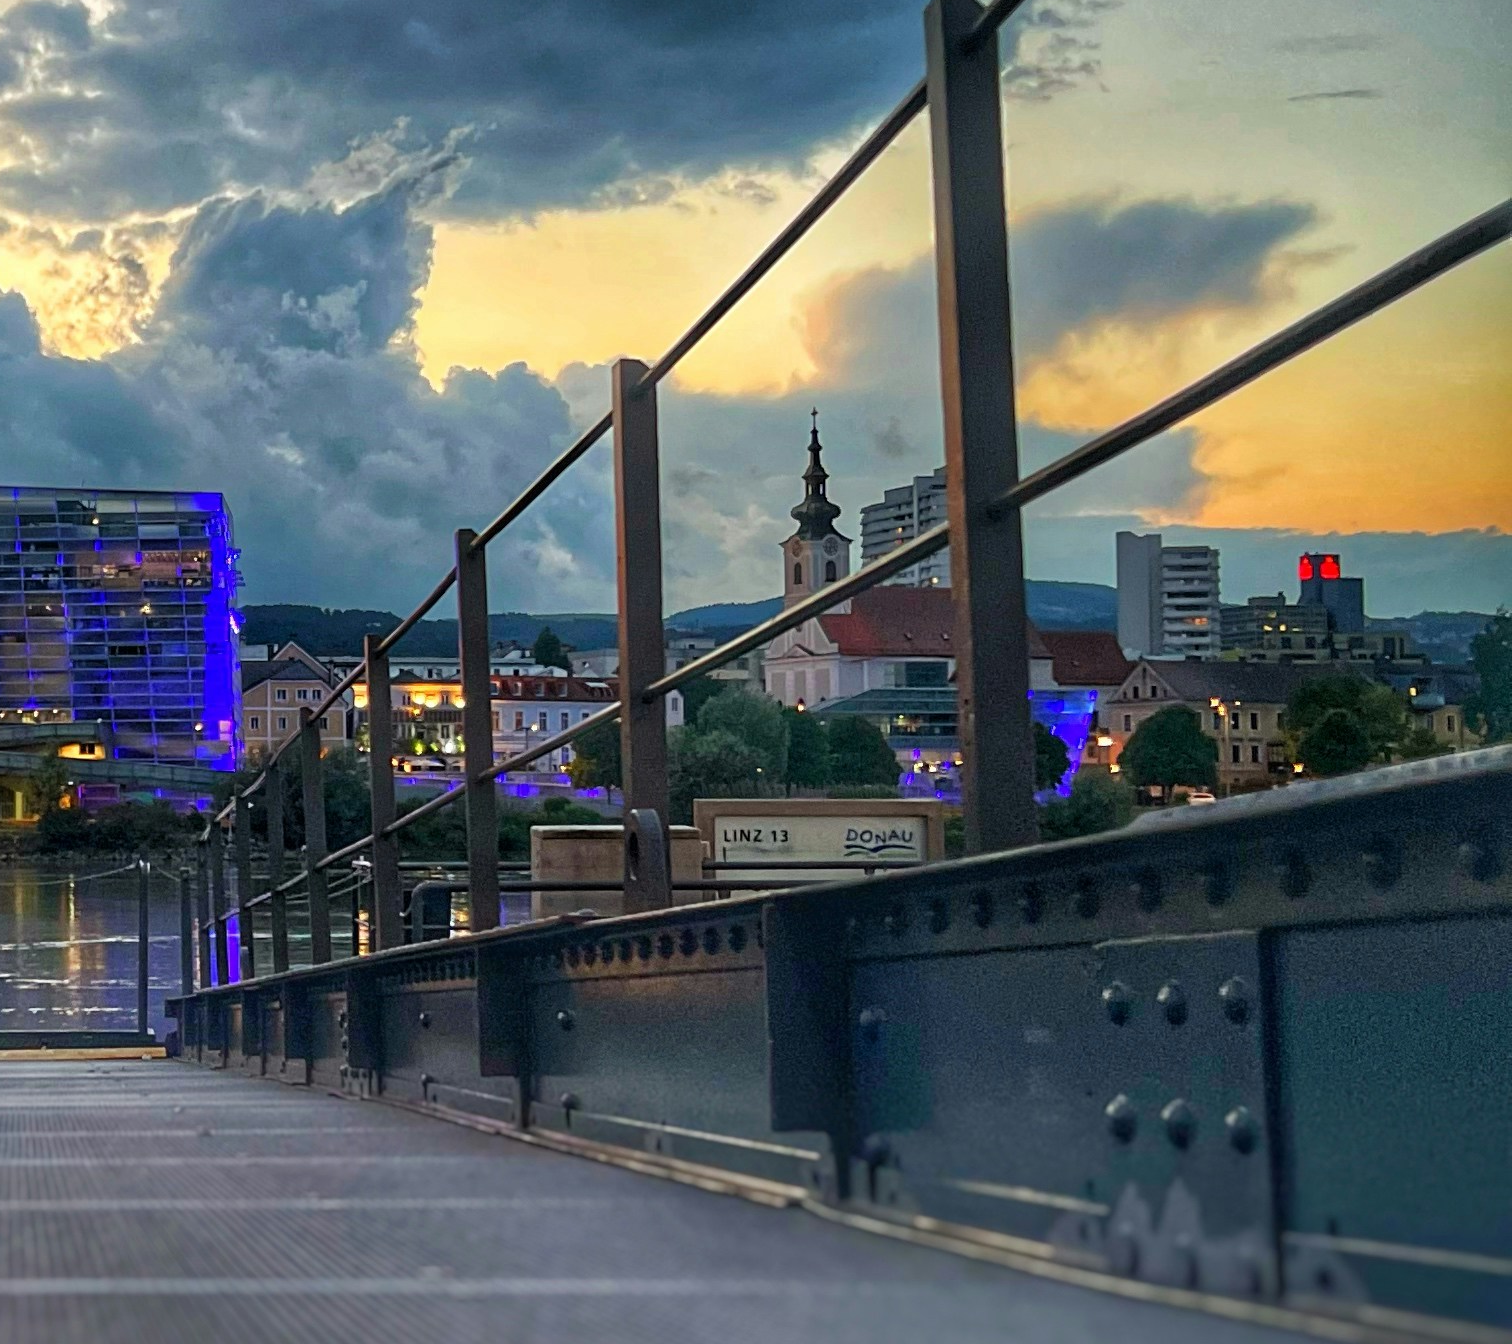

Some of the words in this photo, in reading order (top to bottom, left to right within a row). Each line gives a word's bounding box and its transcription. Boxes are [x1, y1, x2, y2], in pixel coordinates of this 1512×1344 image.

[723, 829, 763, 843] LINZ
[771, 829, 789, 843] 13
[845, 828, 913, 844] DONAU
